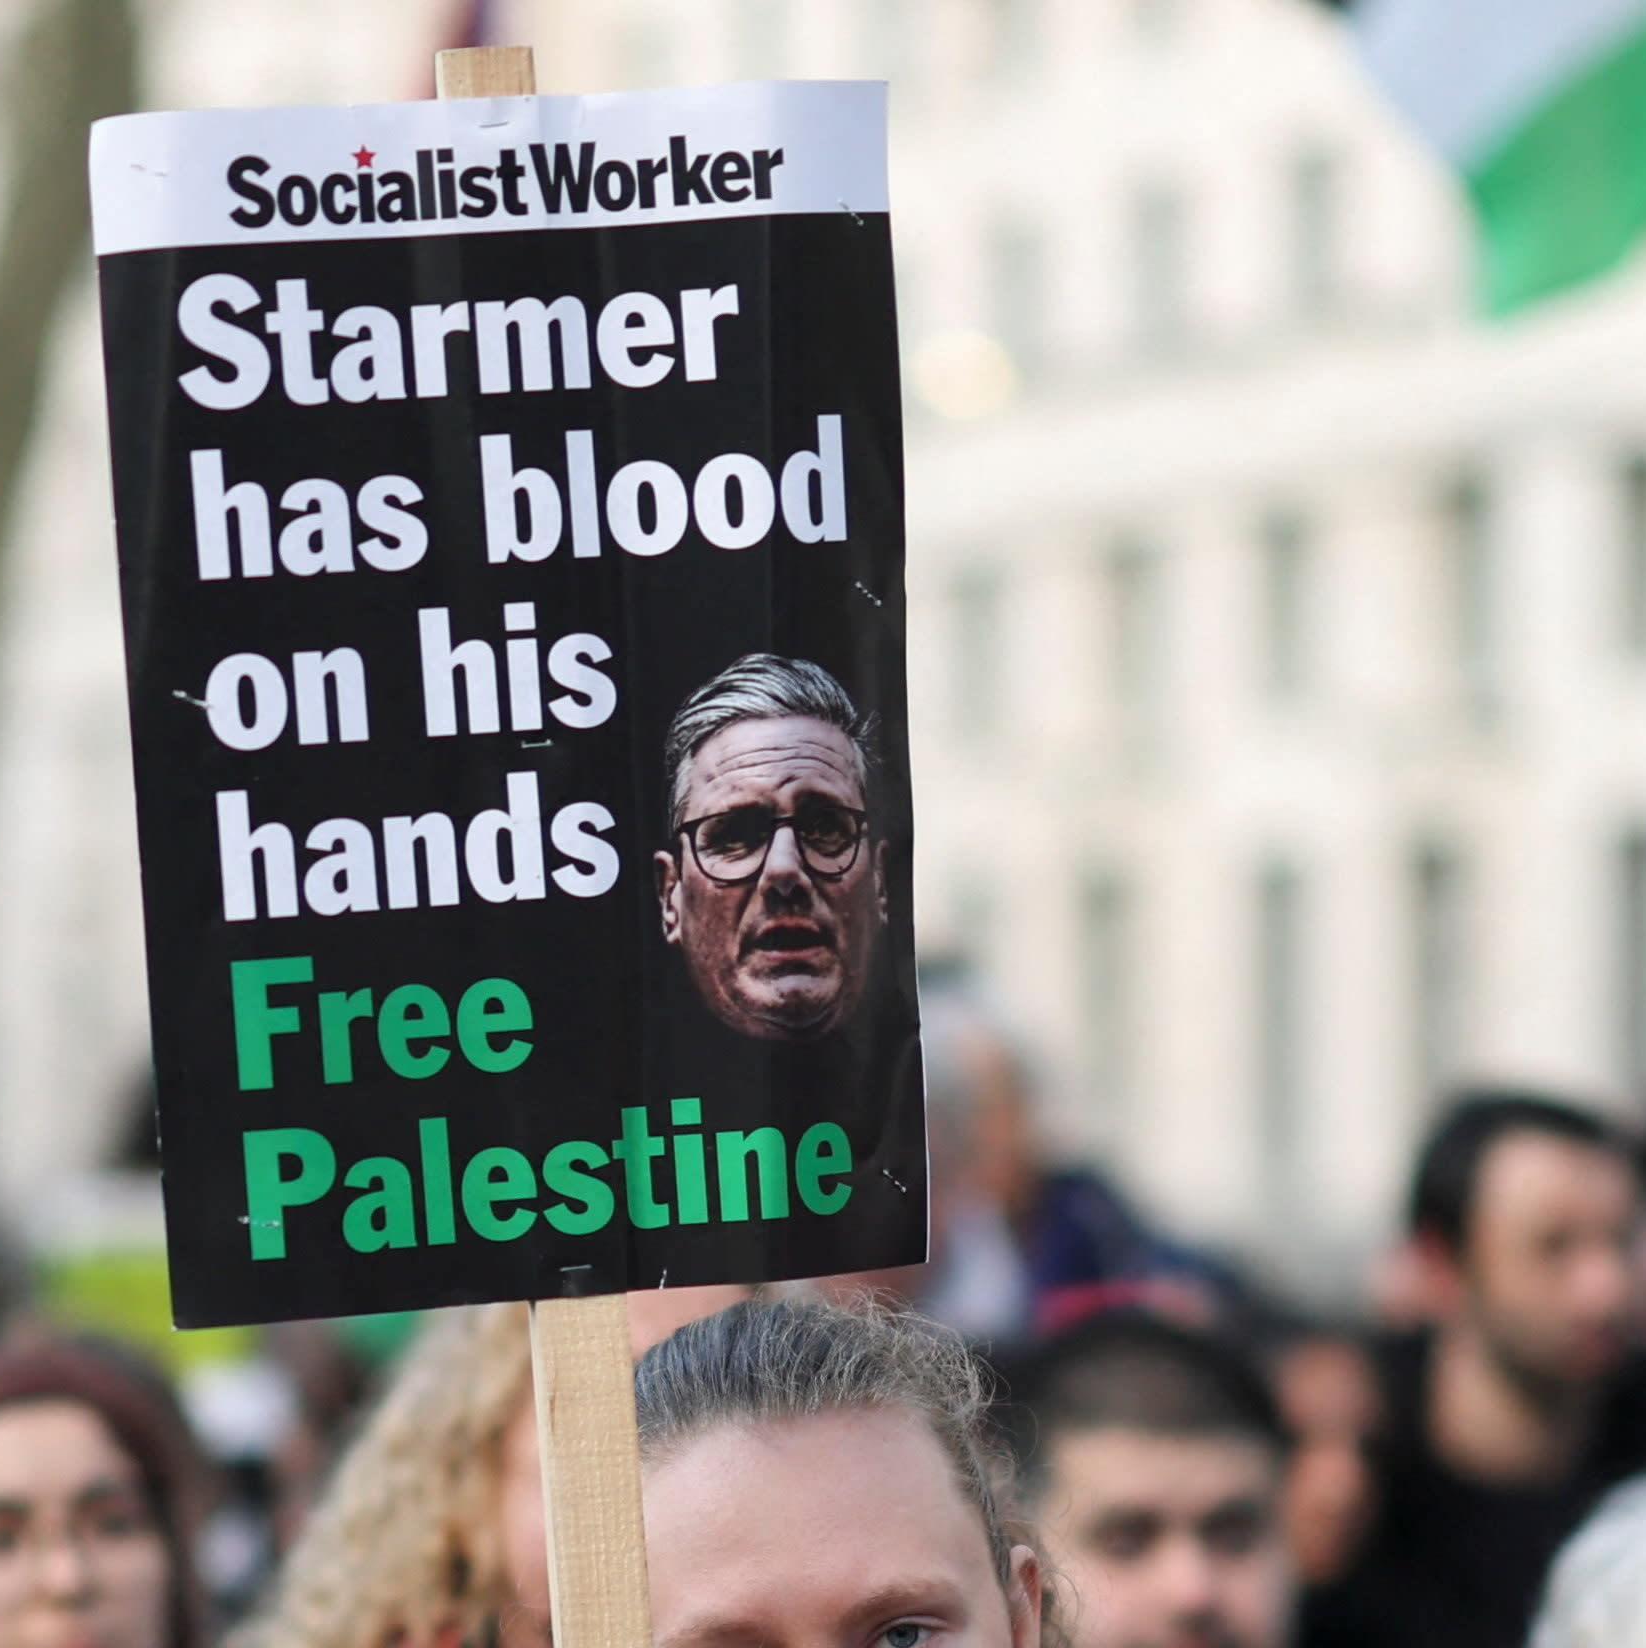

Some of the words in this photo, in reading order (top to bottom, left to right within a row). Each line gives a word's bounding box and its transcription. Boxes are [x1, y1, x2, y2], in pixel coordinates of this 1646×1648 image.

[228, 145, 527, 228] Socialist
[530, 136, 784, 214] Worker
[176, 272, 740, 411] Starmer
[190, 448, 429, 581] has
[479, 414, 848, 564] blood
[204, 646, 370, 751] on
[418, 601, 618, 738] his
[215, 771, 620, 922] hands
[230, 955, 535, 1091] Free
[241, 1097, 854, 1261] Palestine
